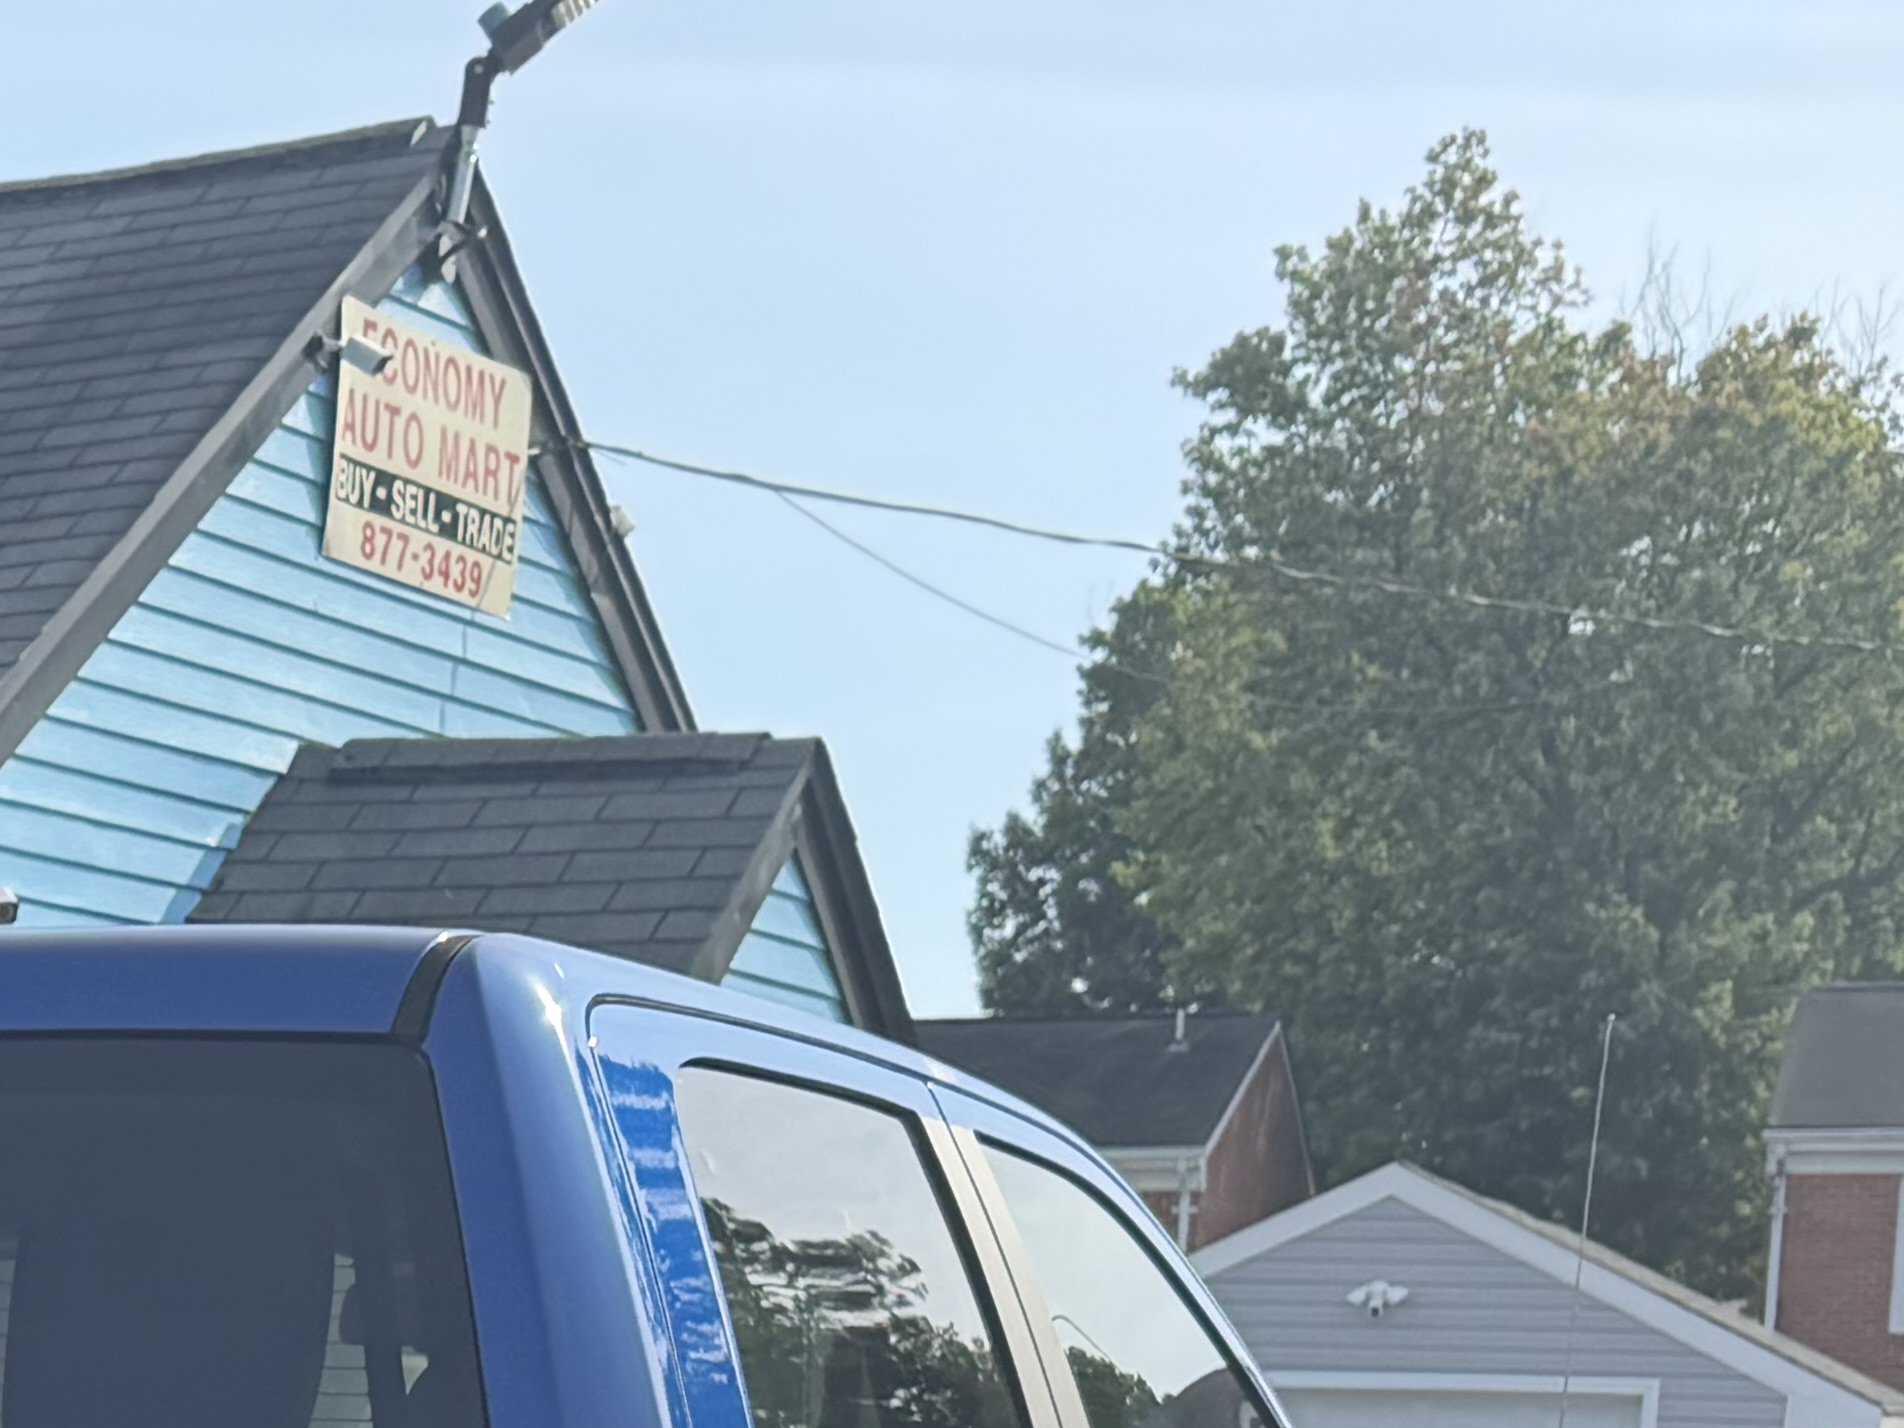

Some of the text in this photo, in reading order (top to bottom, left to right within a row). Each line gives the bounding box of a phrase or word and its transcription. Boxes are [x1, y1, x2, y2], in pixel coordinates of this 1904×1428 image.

[342, 387, 521, 509] AUTO MART
[335, 458, 516, 562] BUY SELL TRADE
[360, 519, 483, 599] 877-3439
